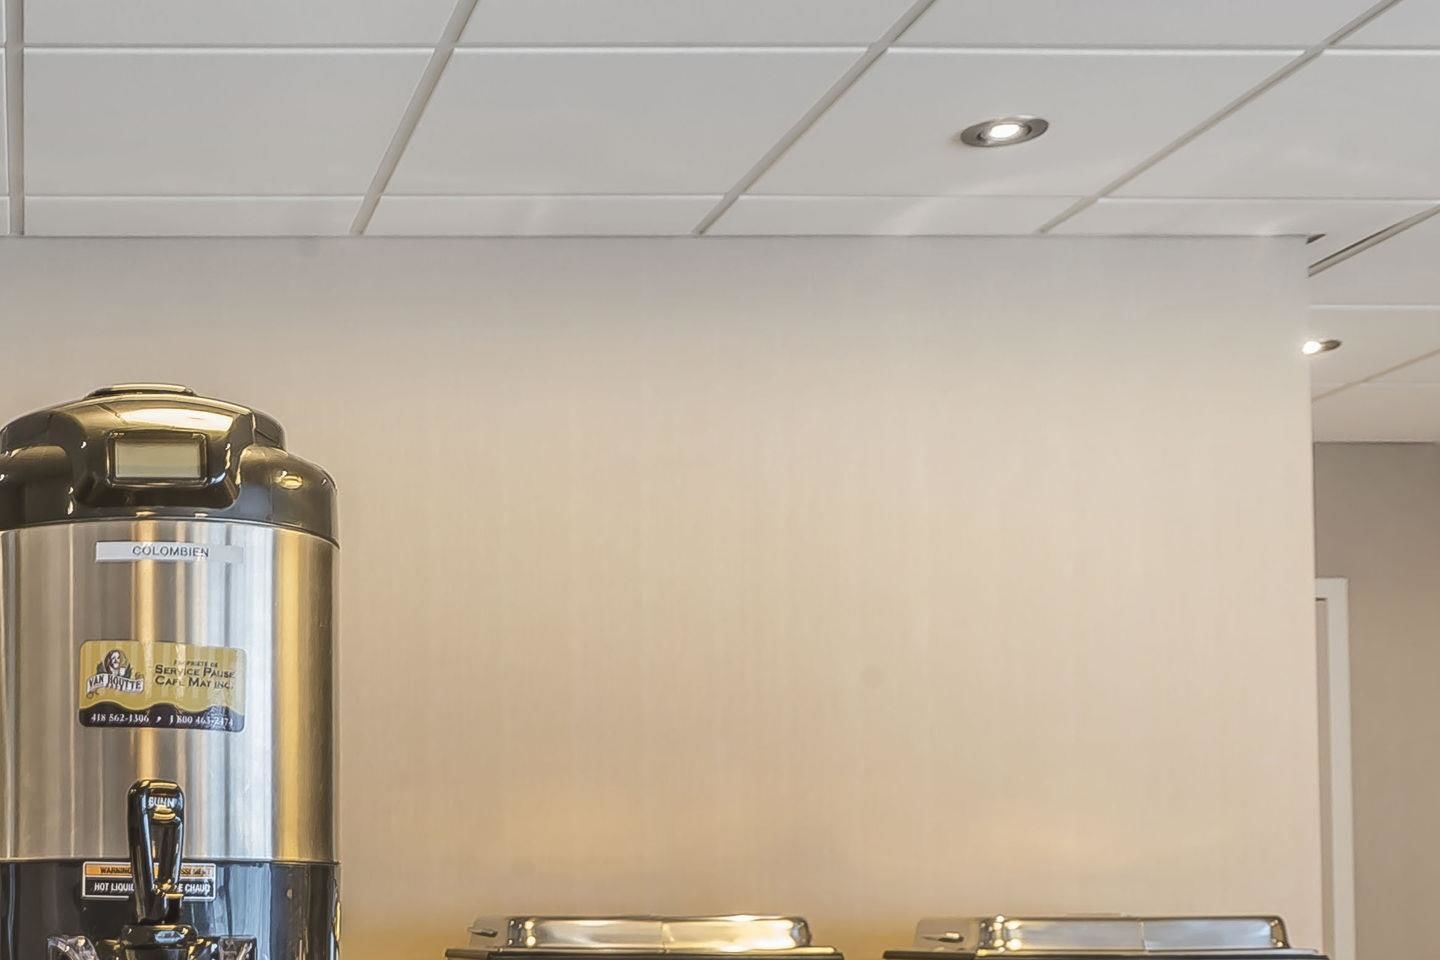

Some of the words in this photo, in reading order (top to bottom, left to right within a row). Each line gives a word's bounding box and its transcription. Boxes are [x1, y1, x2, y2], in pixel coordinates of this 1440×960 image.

[132, 545, 209, 558] COLOMBIEN
[155, 664, 200, 677] SERVICE
[203, 667, 236, 679] PAUSE
[89, 675, 104, 687] VAN
[106, 674, 142, 691] HOUTTE
[91, 713, 106, 722] 418
[94, 882, 109, 892] HOT
[184, 883, 211, 894] CHAUD
